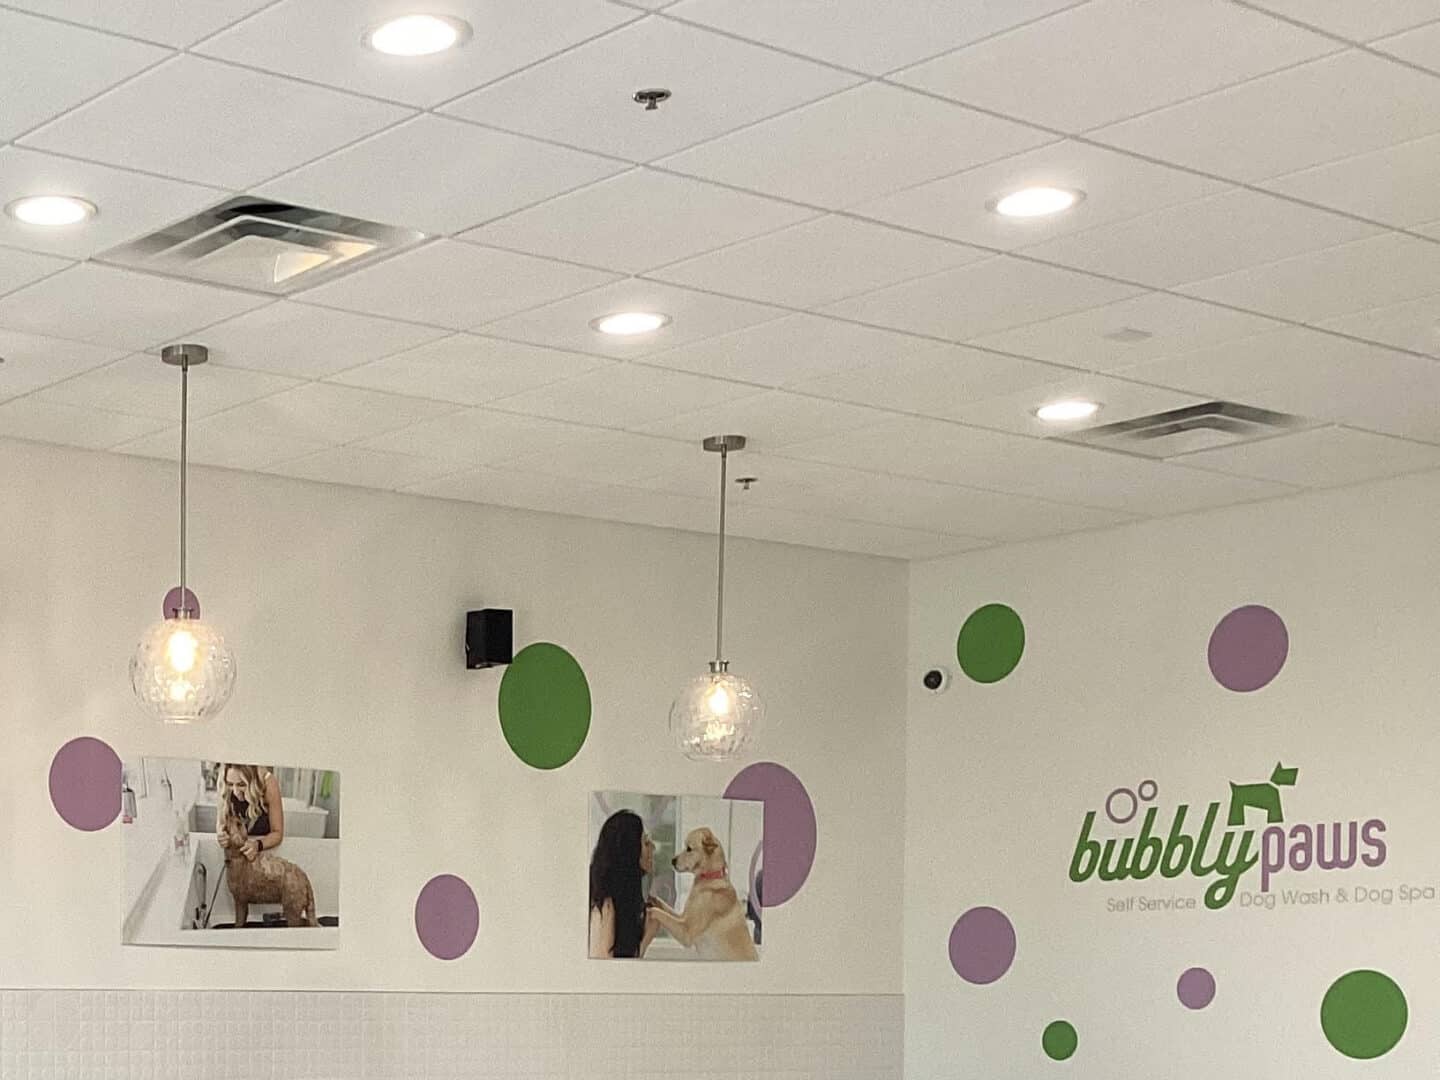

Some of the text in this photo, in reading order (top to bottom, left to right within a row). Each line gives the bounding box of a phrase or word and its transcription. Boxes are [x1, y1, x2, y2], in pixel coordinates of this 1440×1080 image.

[1107, 884, 1435, 912] Self Service Dog Wash & Dog Spa
